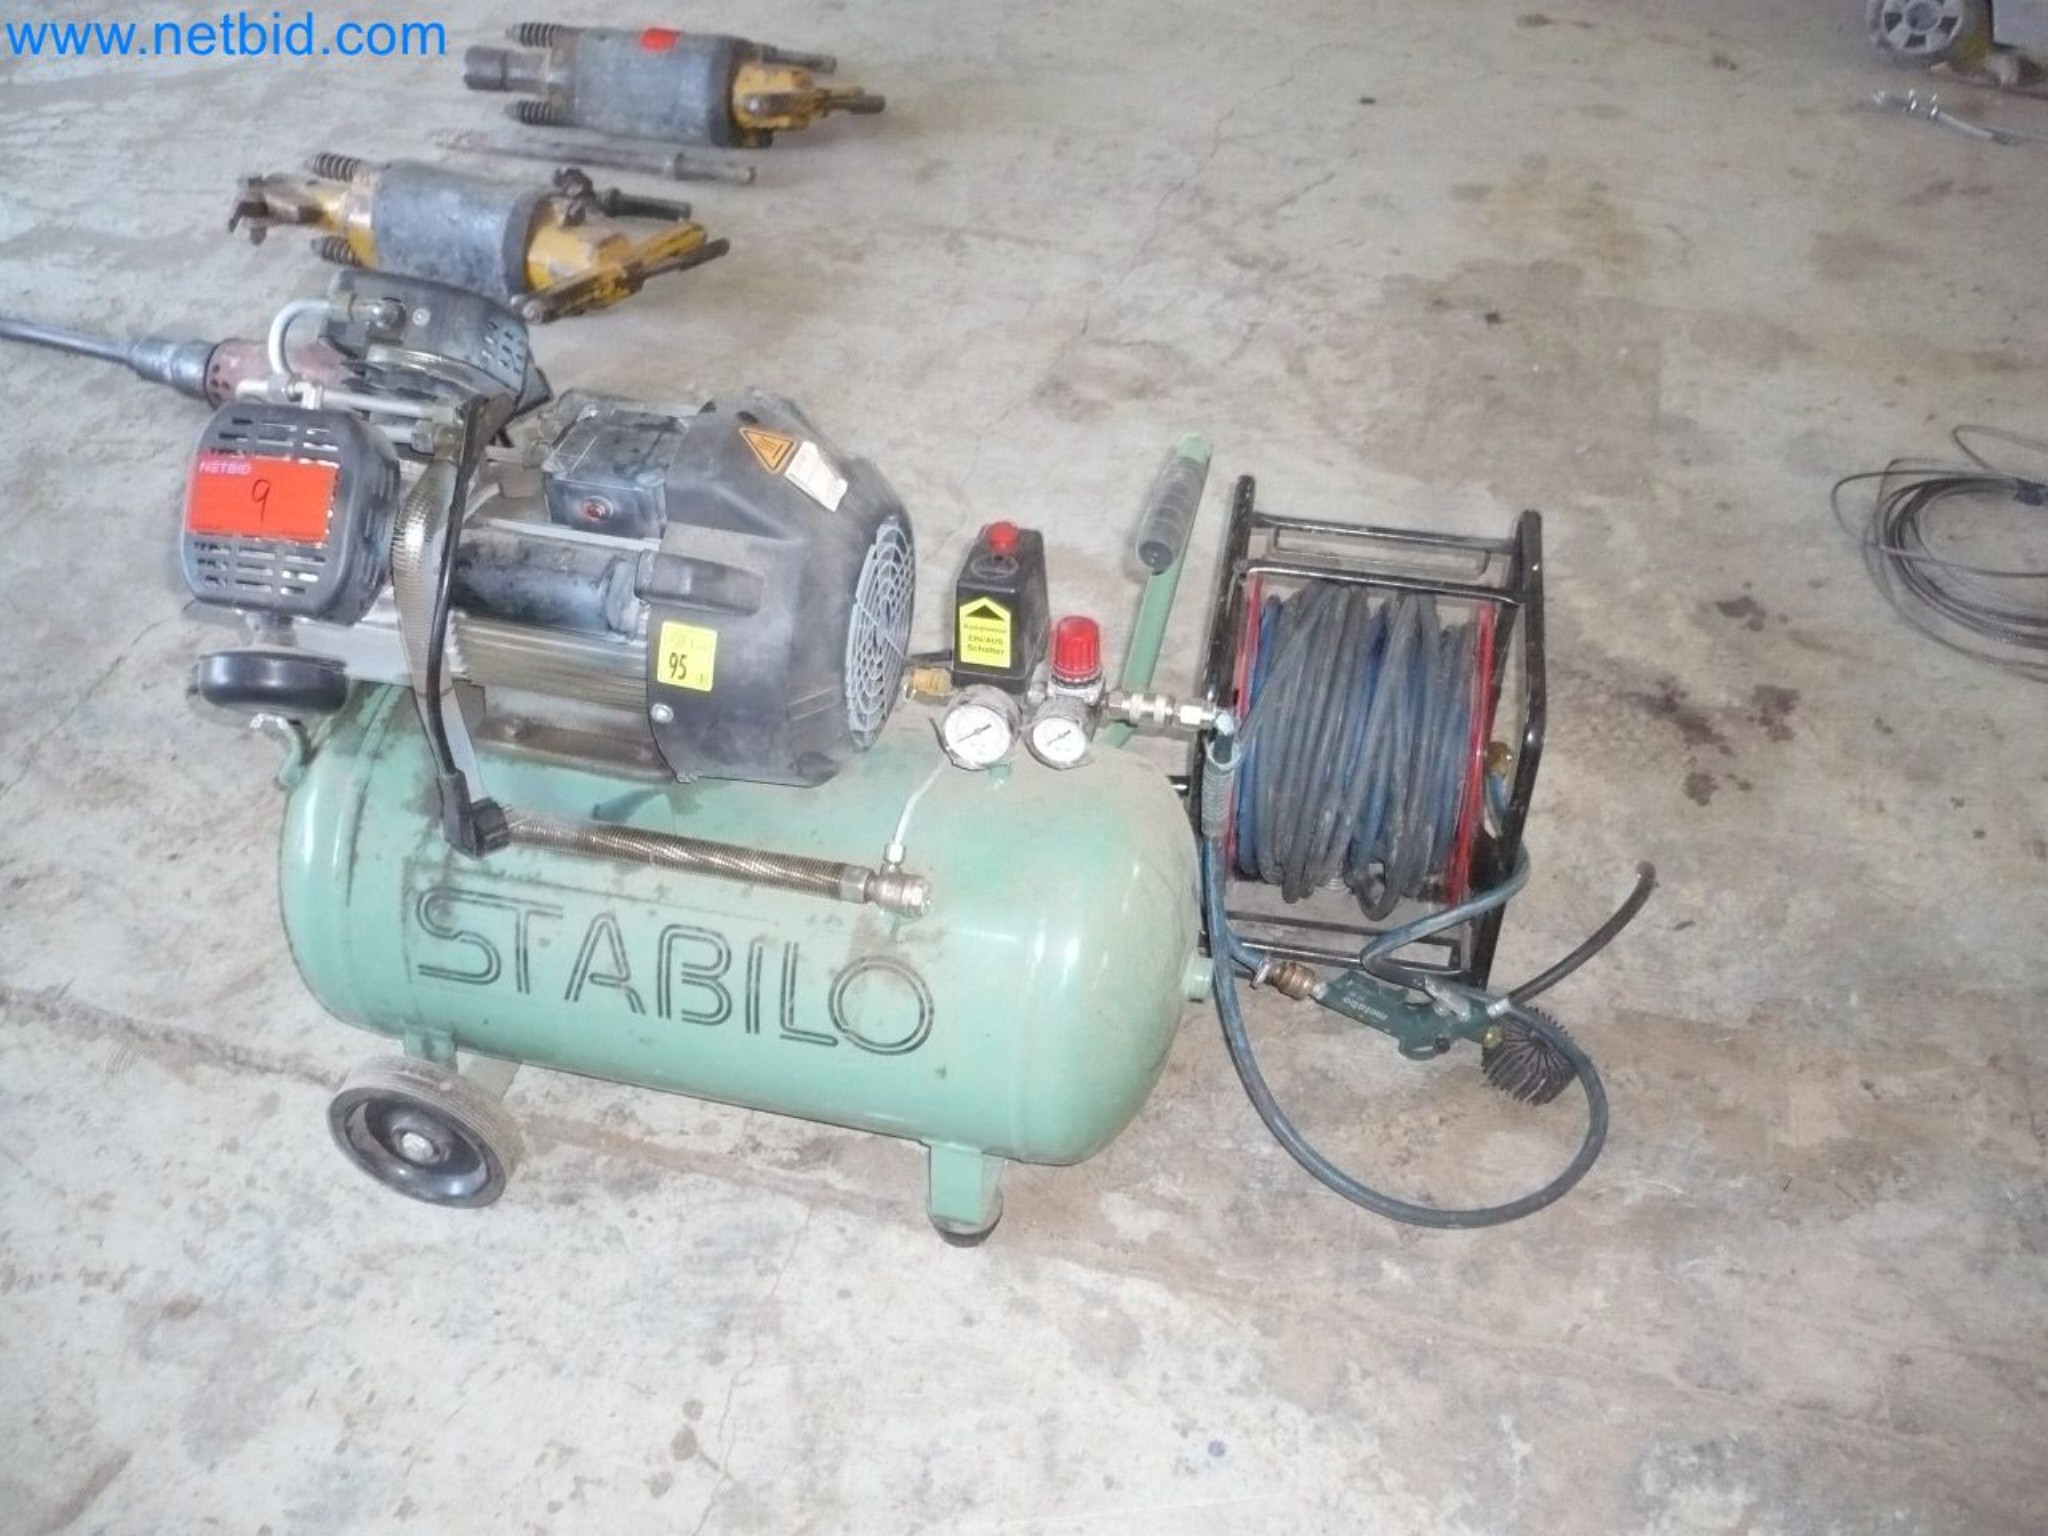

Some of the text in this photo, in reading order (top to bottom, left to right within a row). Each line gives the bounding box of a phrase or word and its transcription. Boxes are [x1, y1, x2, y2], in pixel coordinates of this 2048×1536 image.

[252, 479, 271, 525] 9
[669, 651, 688, 681] 95
[416, 886, 934, 1056] STABILO
